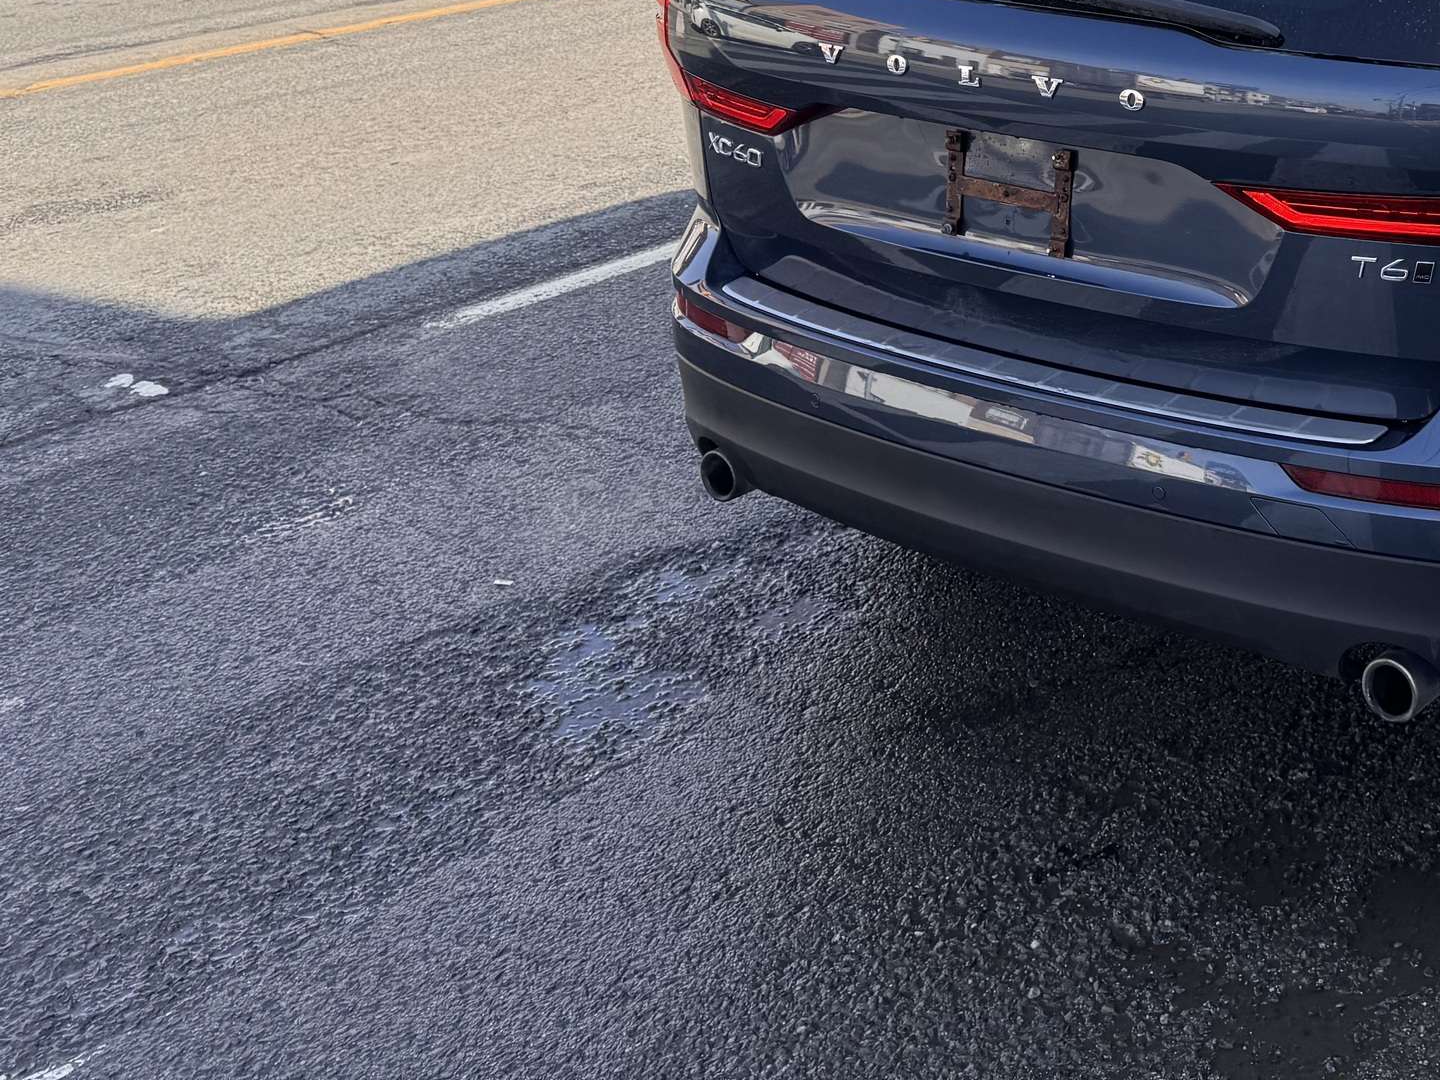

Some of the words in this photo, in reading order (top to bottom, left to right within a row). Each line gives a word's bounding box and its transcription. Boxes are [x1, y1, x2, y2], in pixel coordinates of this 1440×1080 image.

[818, 40, 1146, 112] VOLVO
[708, 131, 762, 167] XC60
[1351, 255, 1409, 282] T6
